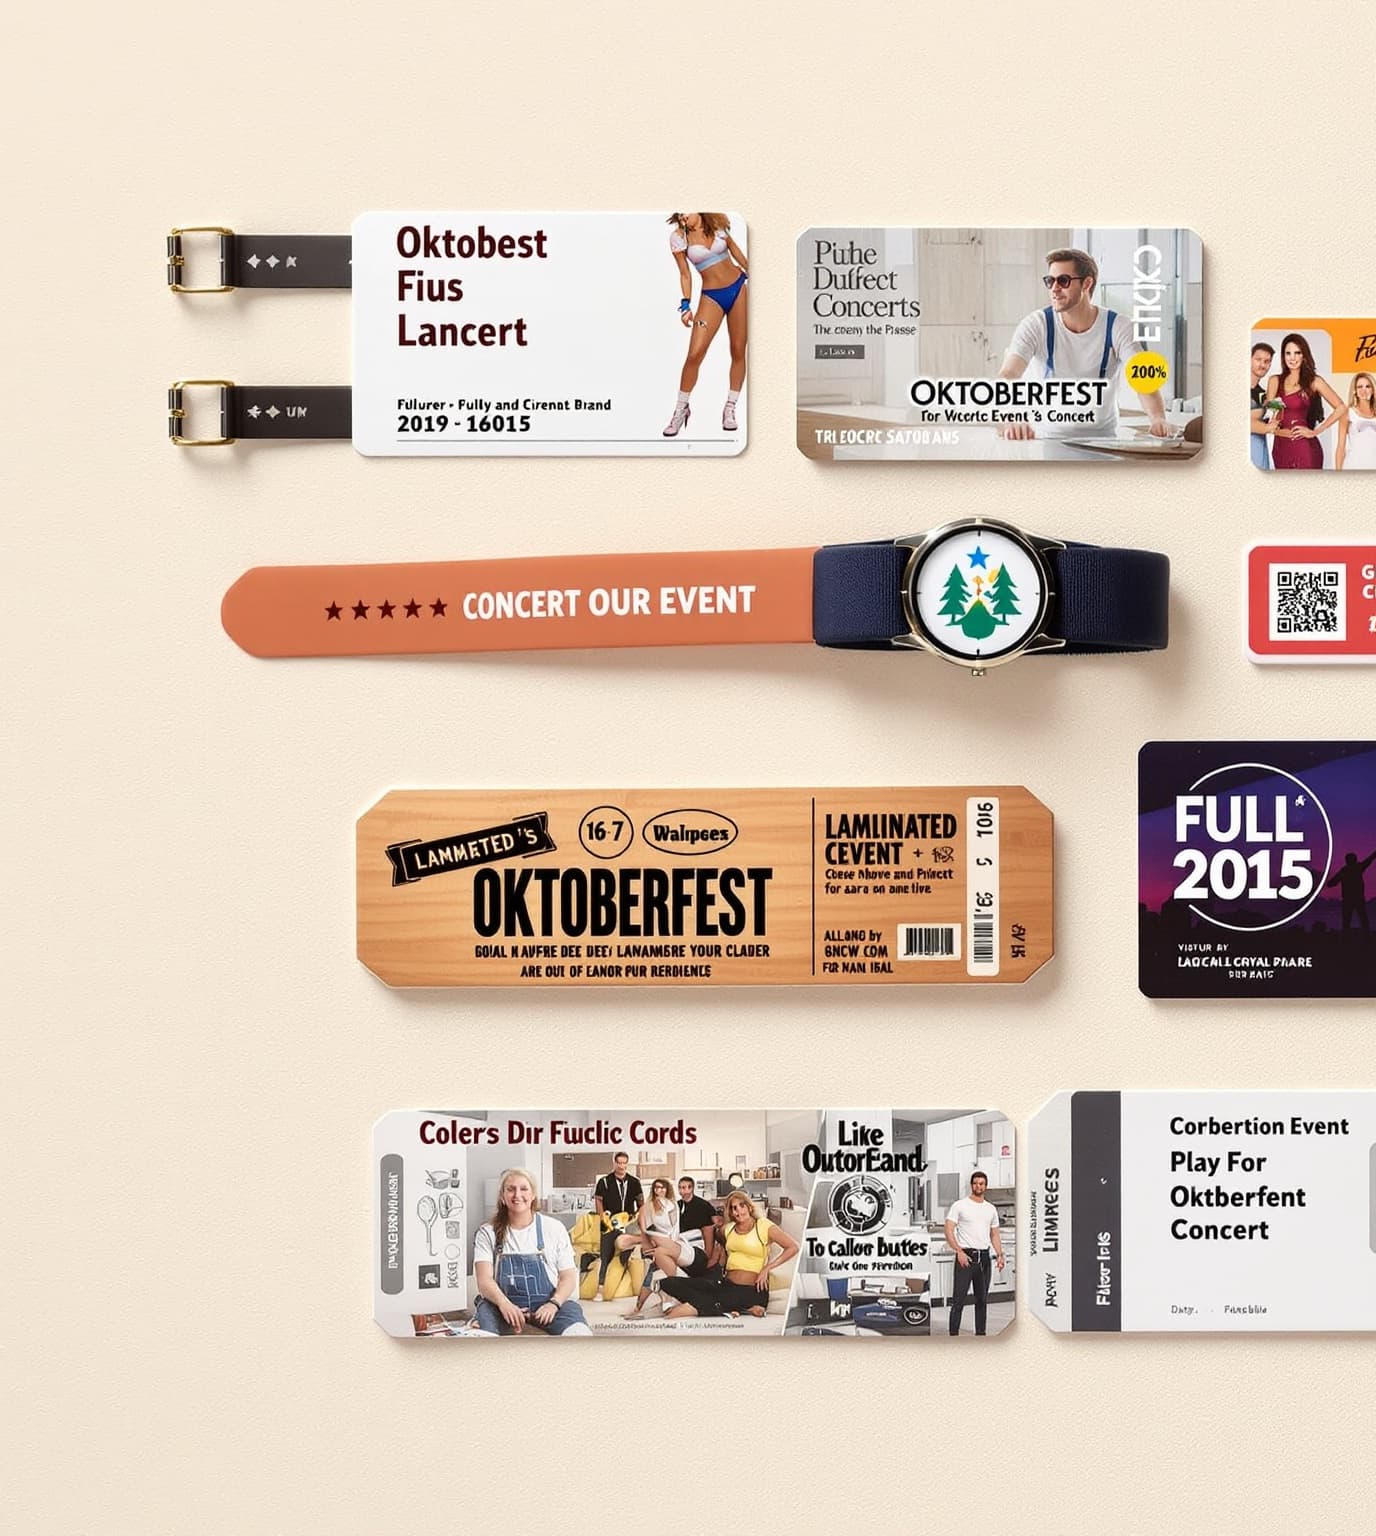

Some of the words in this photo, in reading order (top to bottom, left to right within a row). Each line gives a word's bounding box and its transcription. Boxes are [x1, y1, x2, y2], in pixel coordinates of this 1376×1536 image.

[396, 225, 548, 259] Oktobest
[397, 270, 464, 302] Fius
[813, 293, 921, 318] Concerts
[397, 314, 528, 347] Lancert
[495, 398, 520, 411] and
[911, 380, 1108, 405] OKTOBERFEST
[397, 415, 449, 432] 2019
[467, 415, 531, 432] 16015
[1047, 410, 1095, 423] Concert
[462, 588, 581, 621] CONCERT
[588, 586, 652, 617] OUR
[660, 584, 757, 616] EVENT
[1175, 795, 1304, 843] FULL
[824, 842, 904, 866] CEVENT
[1173, 848, 1314, 901] 2015
[824, 882, 842, 894] for
[473, 867, 773, 938] OKTOBERFEST
[869, 929, 882, 943] by
[690, 944, 722, 958] YOUR
[520, 964, 542, 978] ARE
[418, 1119, 500, 1145] Colers
[629, 1119, 698, 1145] Cords
[837, 1120, 885, 1146] Like
[1169, 1116, 1285, 1136] Corbertion
[1290, 1116, 1350, 1136] Event
[1170, 1151, 1222, 1178] Play
[1227, 1152, 1268, 1173] For
[1169, 1185, 1307, 1209] Oktberfent
[1169, 1218, 1270, 1241] Concert
[806, 1236, 825, 1257] To
